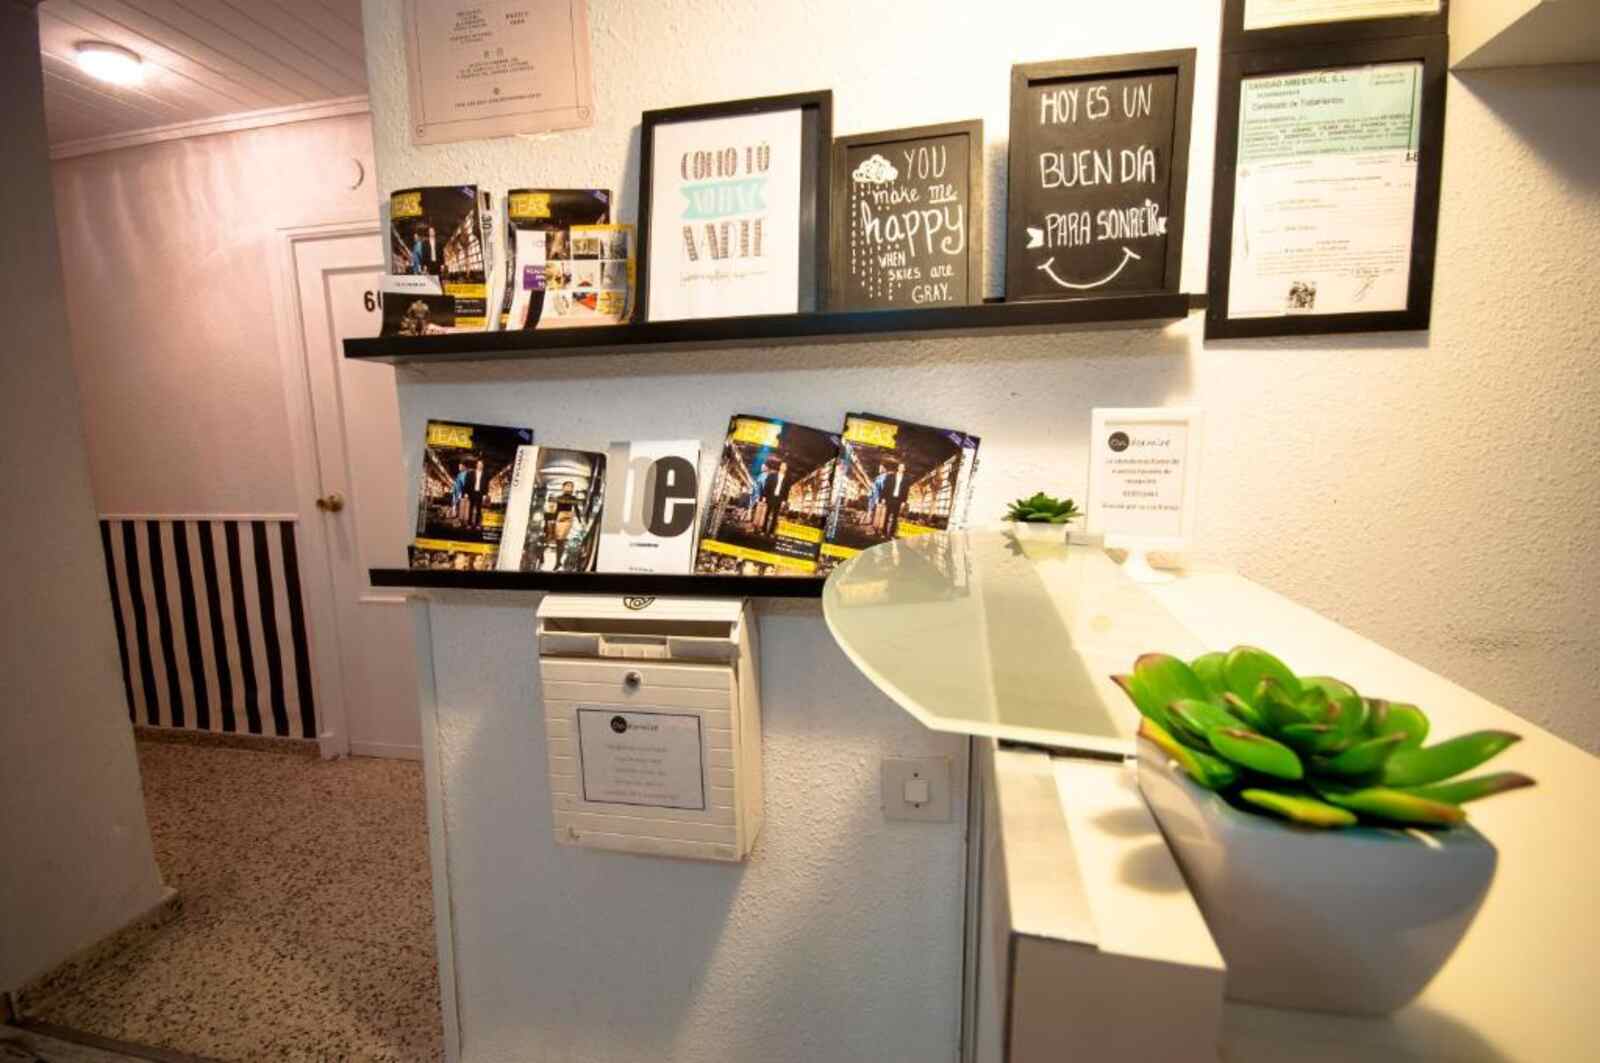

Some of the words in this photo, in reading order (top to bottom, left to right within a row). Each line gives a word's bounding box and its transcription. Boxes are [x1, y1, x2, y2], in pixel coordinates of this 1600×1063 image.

[1041, 88, 1078, 124] HOY
[1086, 86, 1110, 120] ES
[1123, 83, 1152, 118] UN
[904, 145, 946, 179] YOU
[1040, 149, 1113, 188] BUEN
[1120, 145, 1155, 184] DÍA
[872, 183, 920, 205] make
[860, 200, 965, 256] happy
[1046, 211, 1092, 248] PARA
[878, 251, 906, 268] WHEN
[930, 265, 954, 278] are
